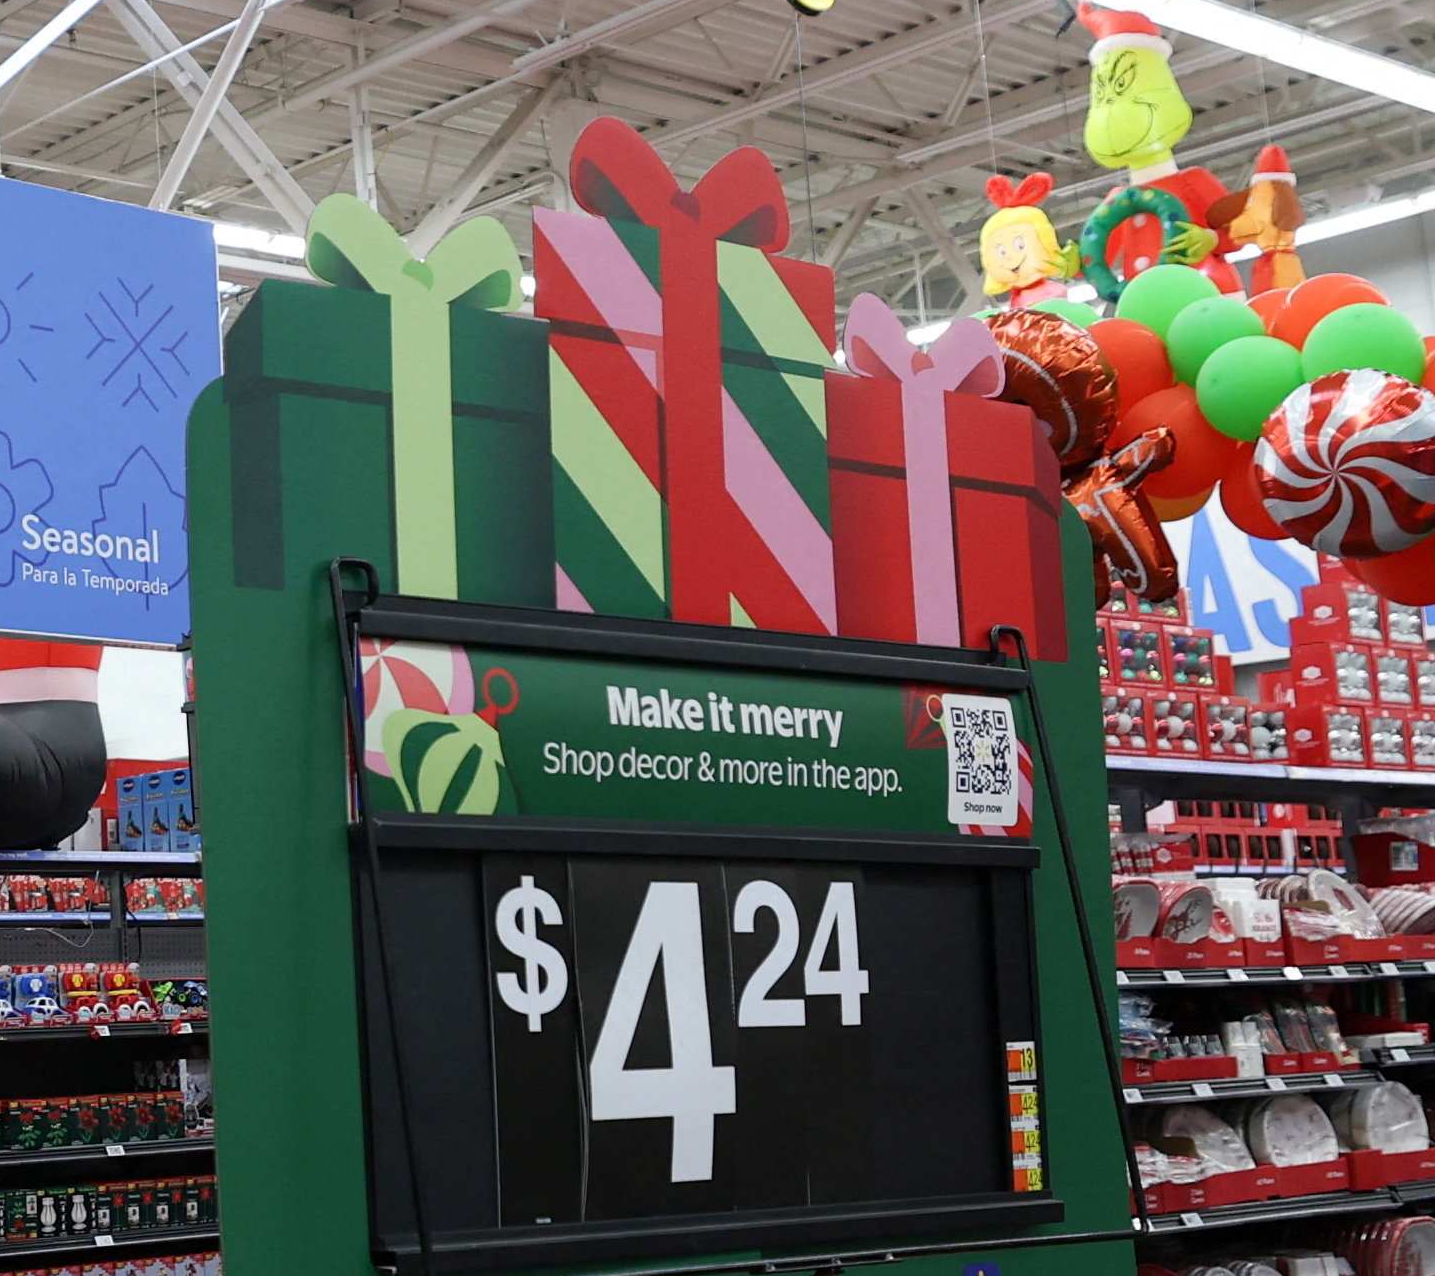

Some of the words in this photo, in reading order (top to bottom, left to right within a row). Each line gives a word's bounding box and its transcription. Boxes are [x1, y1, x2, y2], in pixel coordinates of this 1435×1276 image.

[20, 513, 160, 565] Seasonal
[21, 563, 59, 588] Para
[63, 565, 77, 589] la
[81, 569, 169, 596] Temporada
[605, 684, 706, 732] Make
[708, 691, 735, 734] it
[739, 702, 845, 747] merry
[542, 741, 615, 782] Shop
[618, 745, 693, 781] decor
[697, 751, 716, 783] &
[719, 757, 784, 787] more
[787, 756, 810, 788] in
[813, 758, 852, 792] the
[855, 765, 904, 797] app.
[964, 800, 985, 815] Shop
[986, 804, 1004, 815] now
